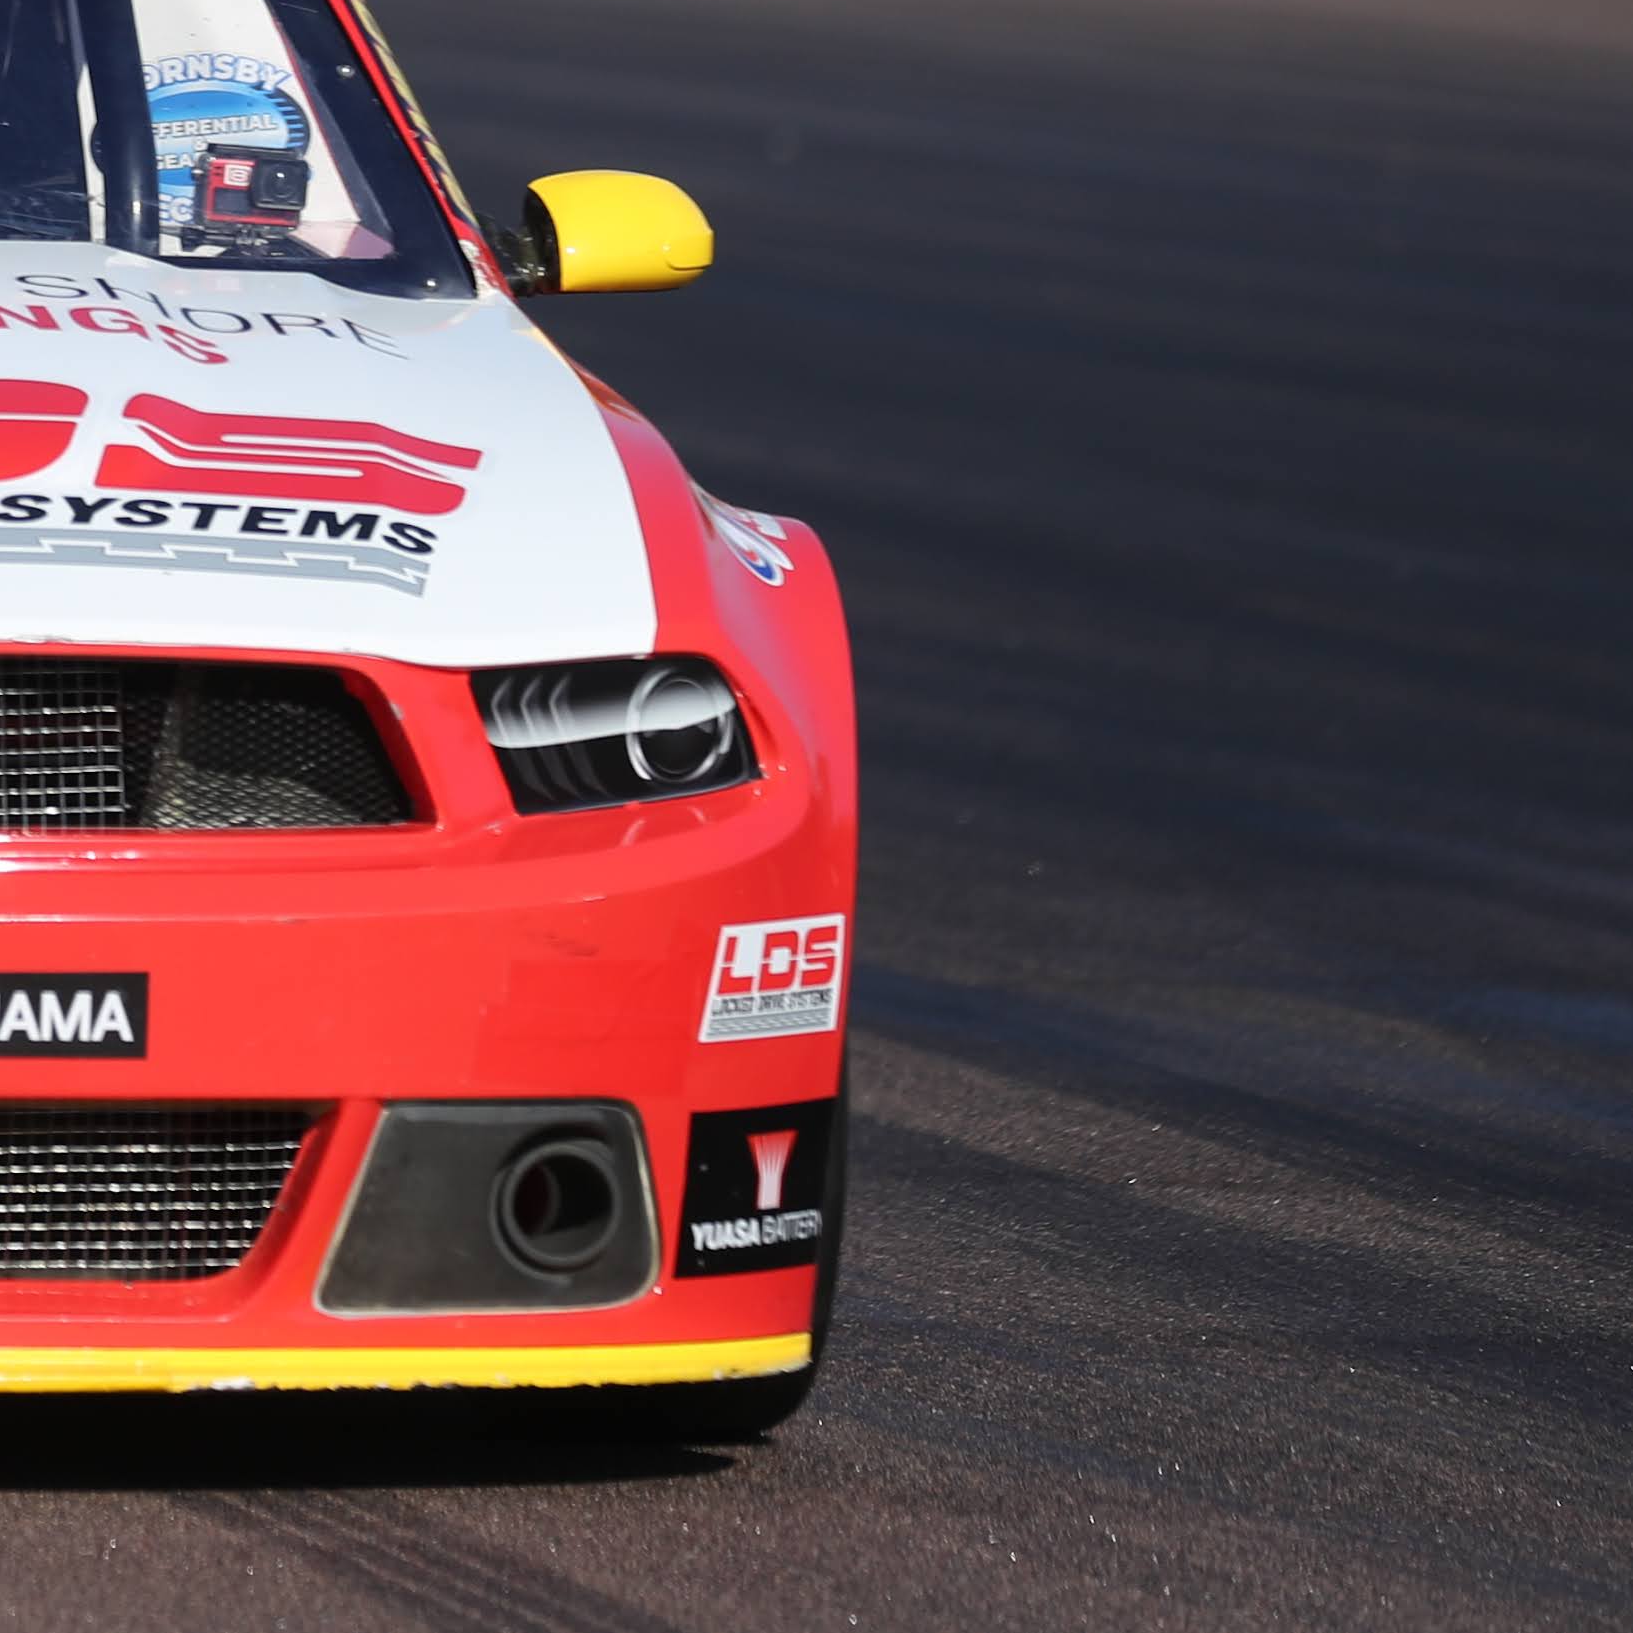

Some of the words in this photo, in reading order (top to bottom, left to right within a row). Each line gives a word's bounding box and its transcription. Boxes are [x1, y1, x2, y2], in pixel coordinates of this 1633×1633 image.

[18, 272, 412, 360] SHORE
[716, 925, 839, 996] LDS
[691, 1218, 761, 1251] YUASA
